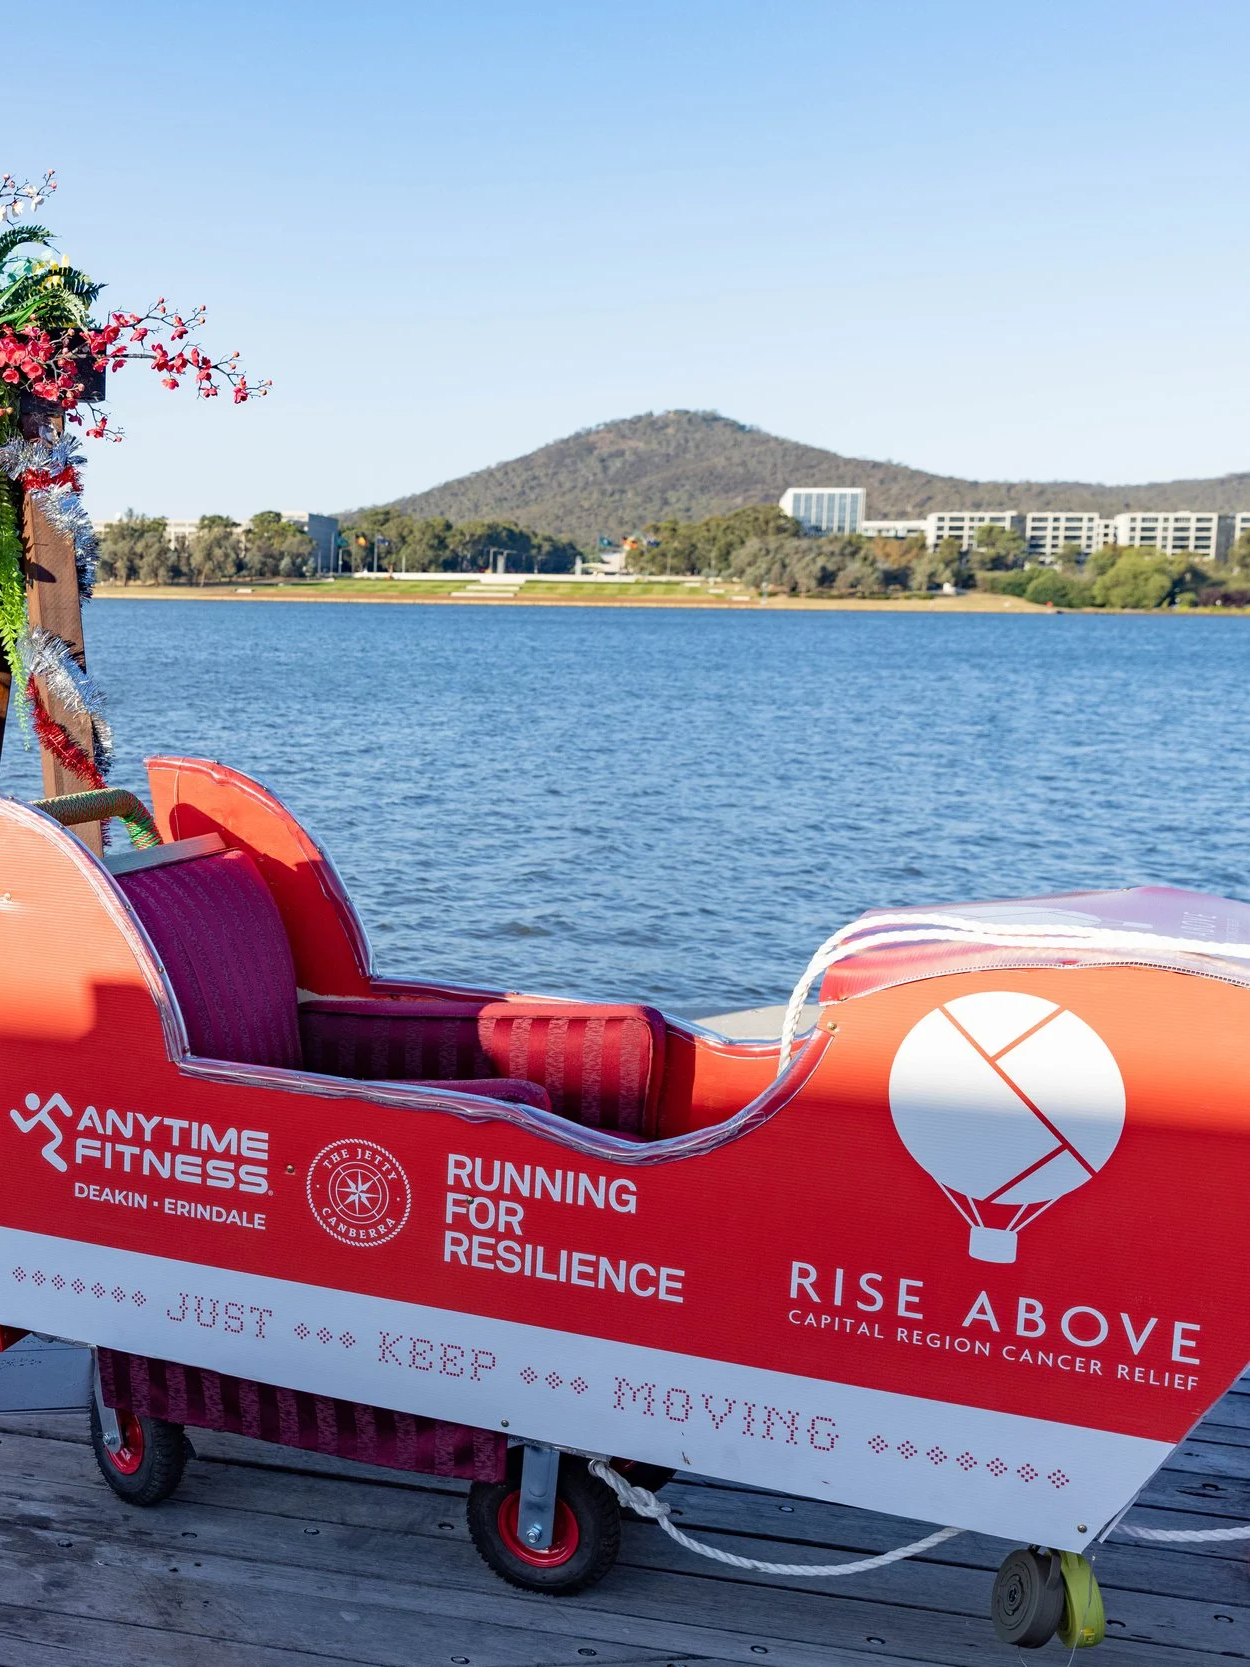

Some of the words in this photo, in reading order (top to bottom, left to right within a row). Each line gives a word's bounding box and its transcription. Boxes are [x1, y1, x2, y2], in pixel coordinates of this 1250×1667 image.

[77, 1106, 268, 1160] ANYTIME
[76, 1138, 268, 1194] FITNESS
[323, 1148, 350, 1169] THE
[356, 1148, 398, 1180] JETTY
[448, 1154, 636, 1213] RUNNING
[74, 1183, 147, 1209] DEAKIN
[165, 1199, 265, 1229] ERINDALE
[322, 1207, 396, 1239] CANBERRA
[446, 1192, 524, 1235] FOR
[444, 1231, 684, 1303] RESILIENCE
[790, 1261, 923, 1319] RISE
[962, 1291, 1200, 1364] ABOVE
[167, 1293, 273, 1338] JUST
[378, 1331, 497, 1380] KEEP
[613, 1376, 839, 1451] MOVING
[789, 1310, 883, 1338] CAPITAL
[898, 1328, 989, 1356] REGION
[1003, 1346, 1102, 1375] CANCER
[1118, 1365, 1198, 1390] RELIEF
